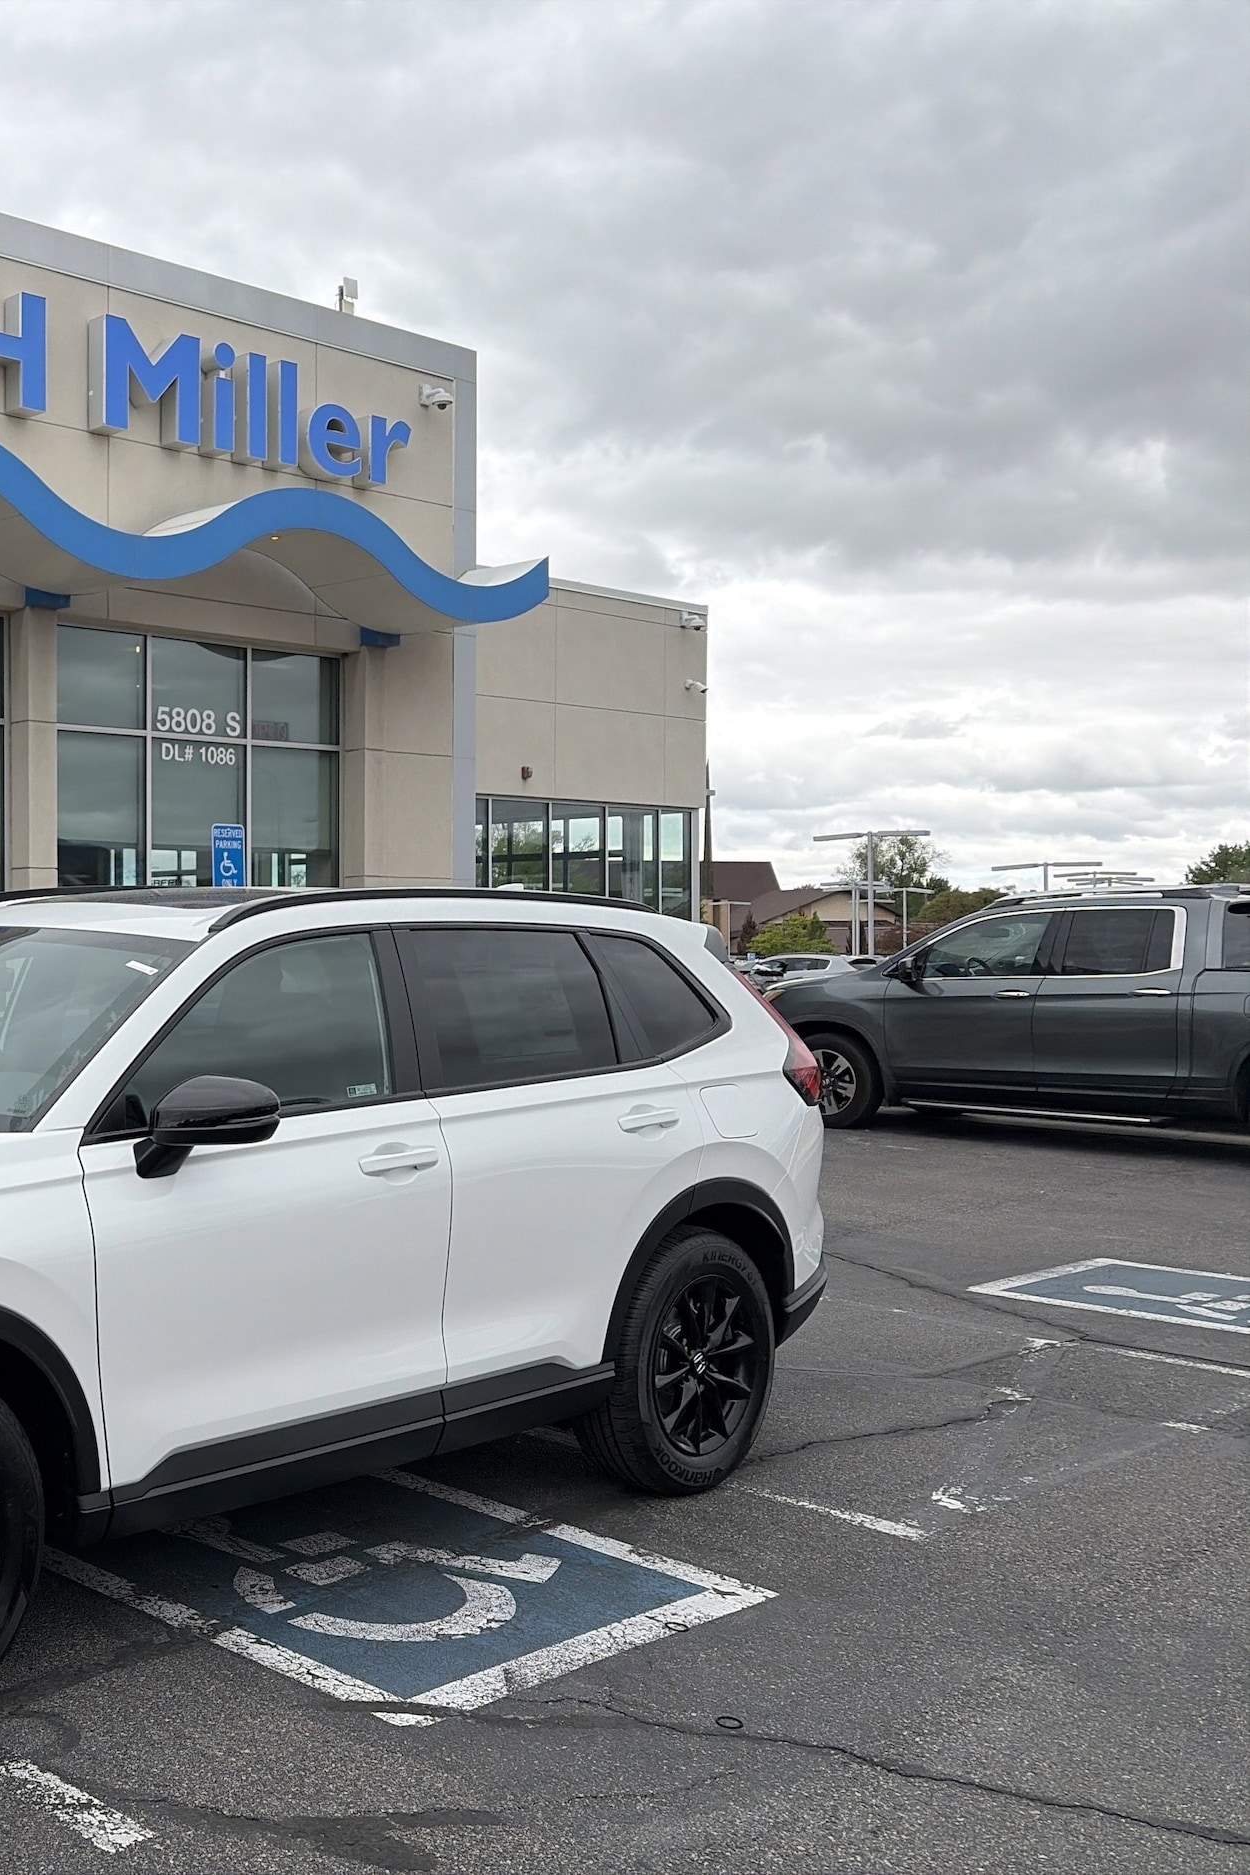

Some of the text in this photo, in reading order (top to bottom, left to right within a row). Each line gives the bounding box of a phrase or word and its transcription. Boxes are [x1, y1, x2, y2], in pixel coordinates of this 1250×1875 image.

[92, 314, 412, 486] Miller
[156, 706, 241, 737] 5808 S
[161, 742, 236, 766] DL# 1086
[213, 828, 243, 839] RESERVED
[215, 839, 242, 850] PARKING
